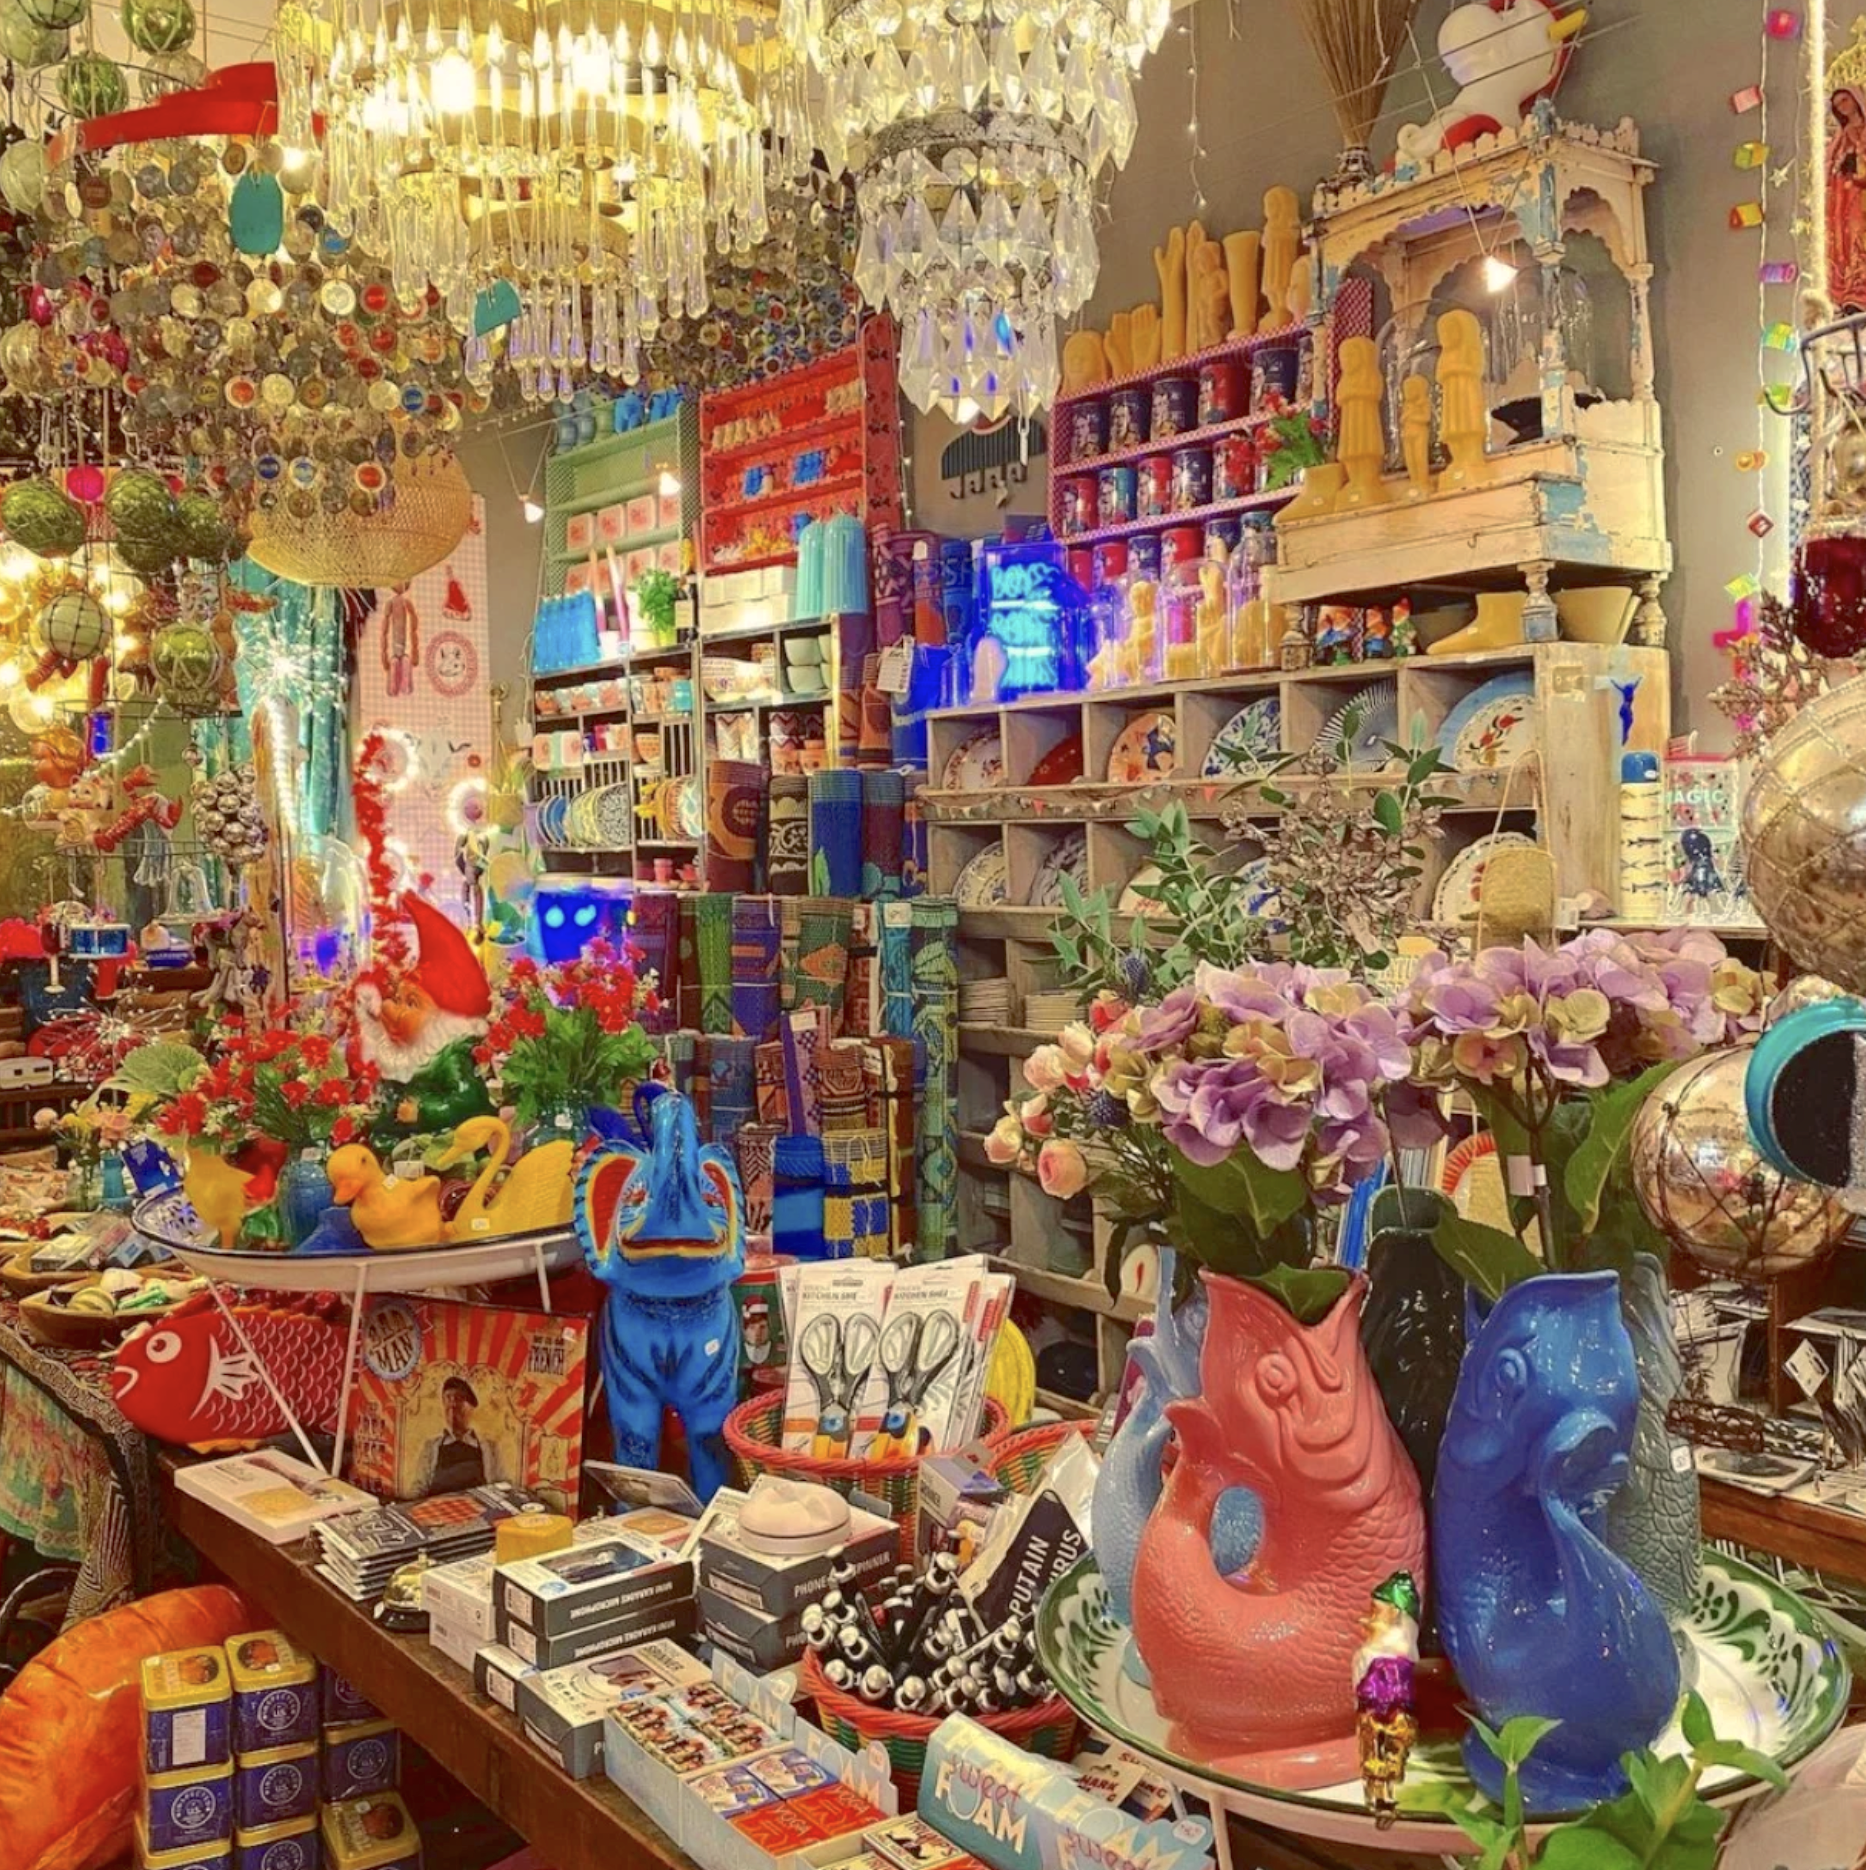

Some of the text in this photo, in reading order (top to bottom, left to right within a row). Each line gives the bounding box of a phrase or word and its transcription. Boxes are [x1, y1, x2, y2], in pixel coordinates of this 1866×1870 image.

[794, 1551, 891, 1598] PHONE PINNER
[1009, 1535, 1050, 1617] PUTAIN
[1048, 1529, 1082, 1584] IRUS
